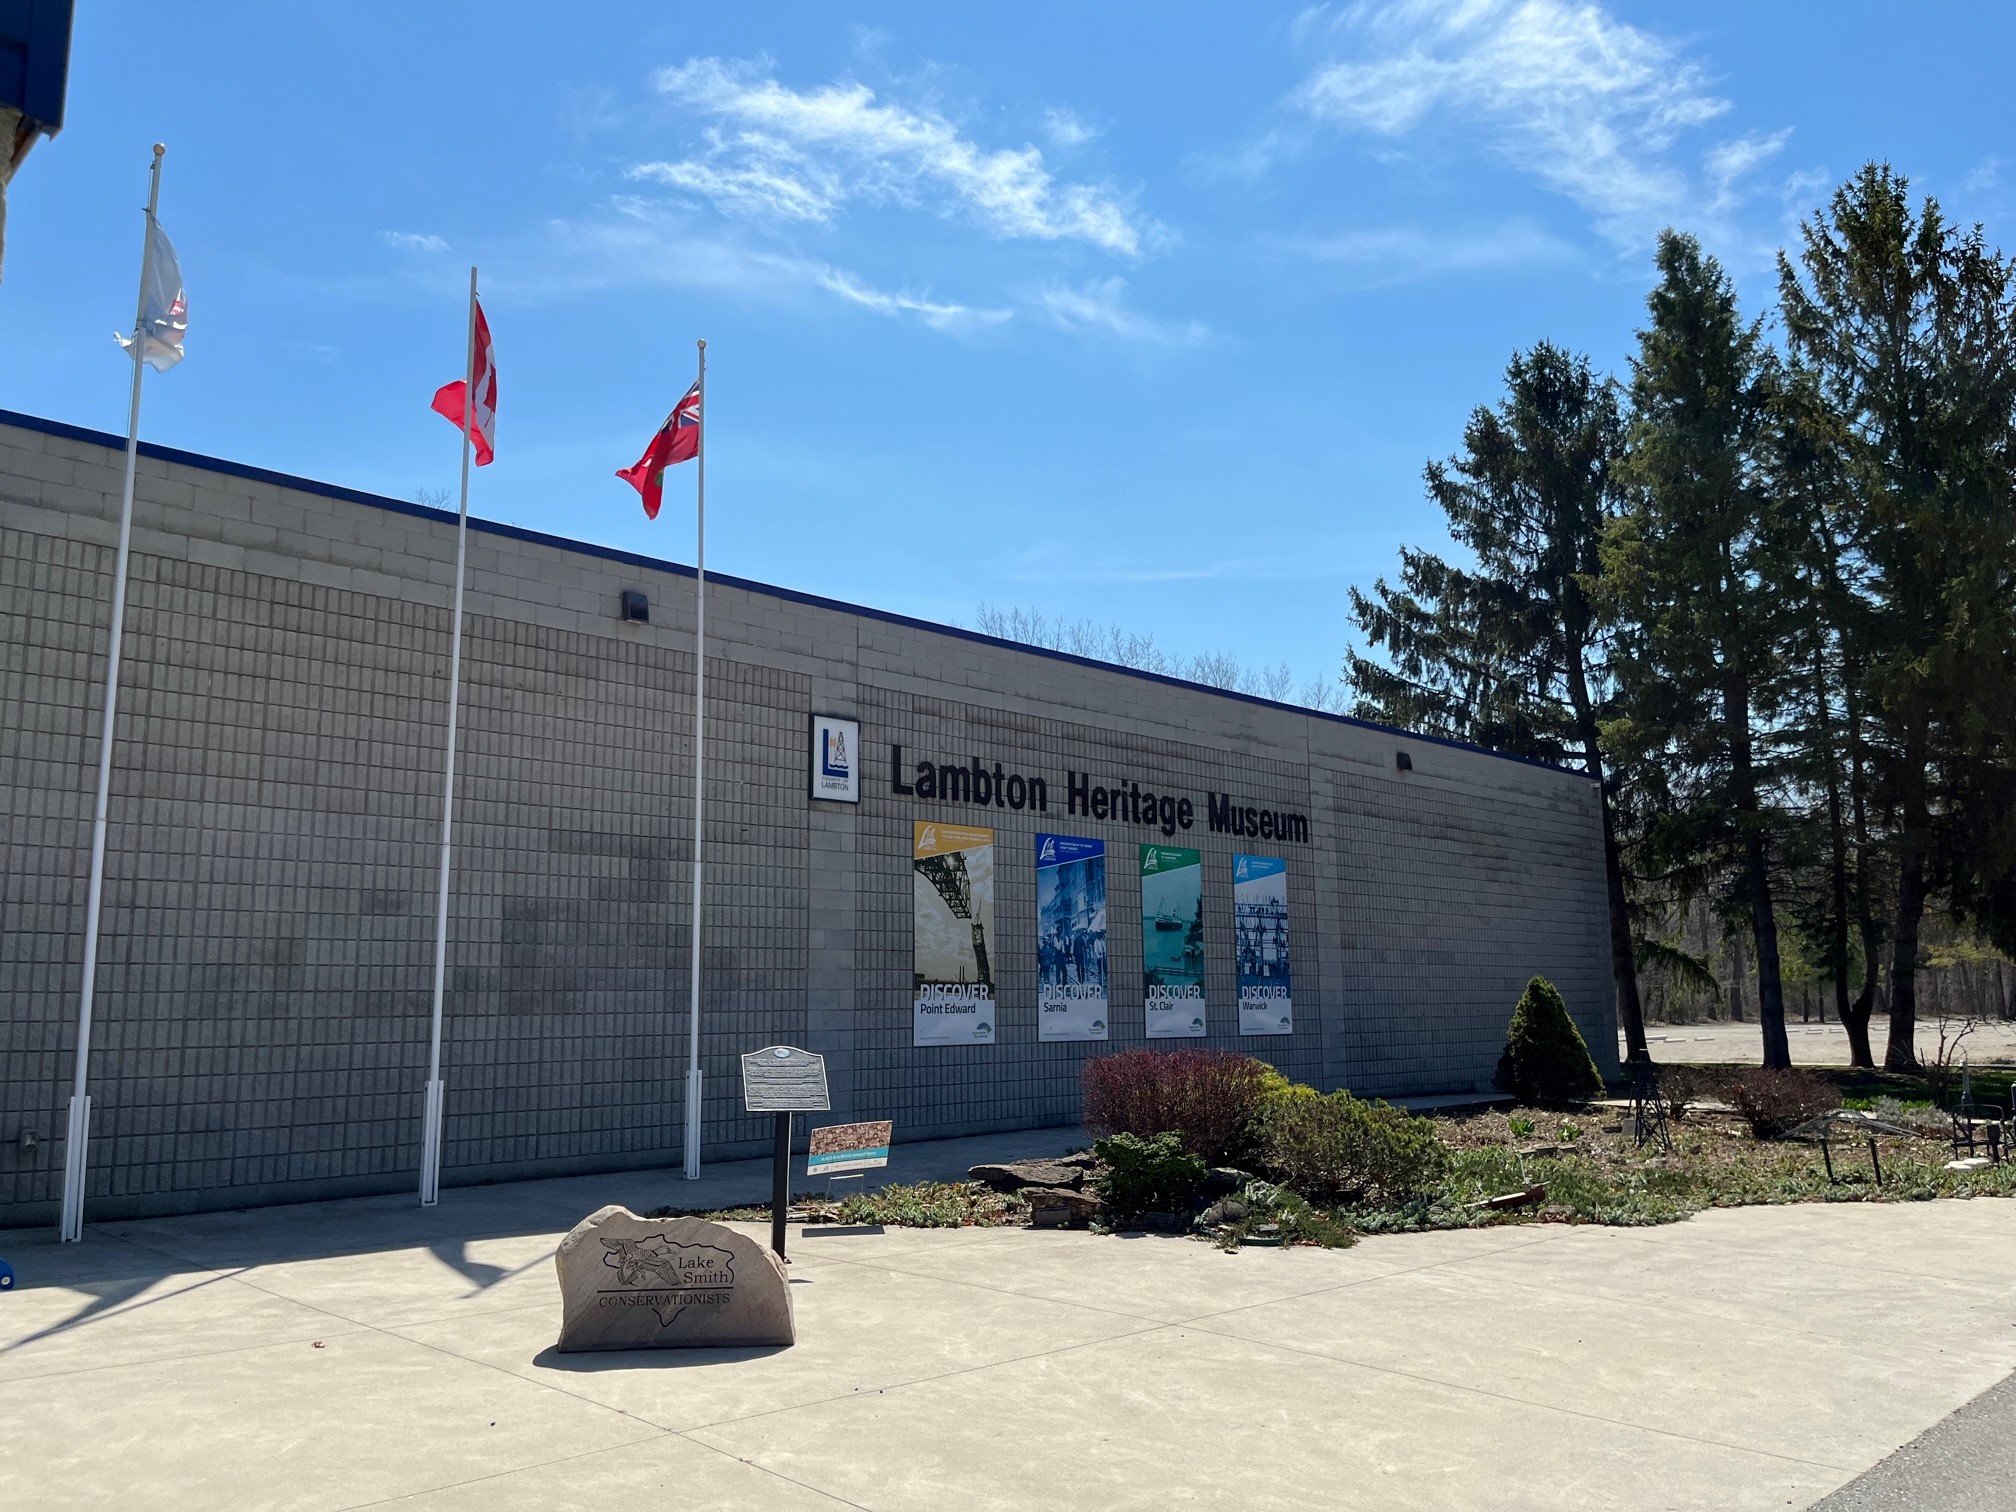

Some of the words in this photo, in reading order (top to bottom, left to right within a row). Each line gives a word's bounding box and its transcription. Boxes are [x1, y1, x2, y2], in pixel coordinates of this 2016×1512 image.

[821, 781, 849, 791] LAMBTON
[892, 744, 1047, 812] Lambton
[1067, 770, 1194, 837] Heritage
[1207, 792, 1309, 843] Museum
[920, 983, 989, 1000] DISCOVER
[1043, 984, 1102, 1000] DISCOVER
[1149, 985, 1201, 999] DISCOVER
[1242, 986, 1287, 999] DISCOVER
[920, 1003, 943, 1014] Point
[945, 1003, 976, 1014] Edward
[1043, 1002, 1067, 1012] Sarnia
[1149, 1001, 1158, 1010] St.
[1160, 1001, 1174, 1010] Clair
[1243, 1001, 1268, 1010] Warwick
[678, 1256, 714, 1269] Lake
[683, 1271, 729, 1284] Smith
[599, 1293, 730, 1307] CONSERVATIONISTS
